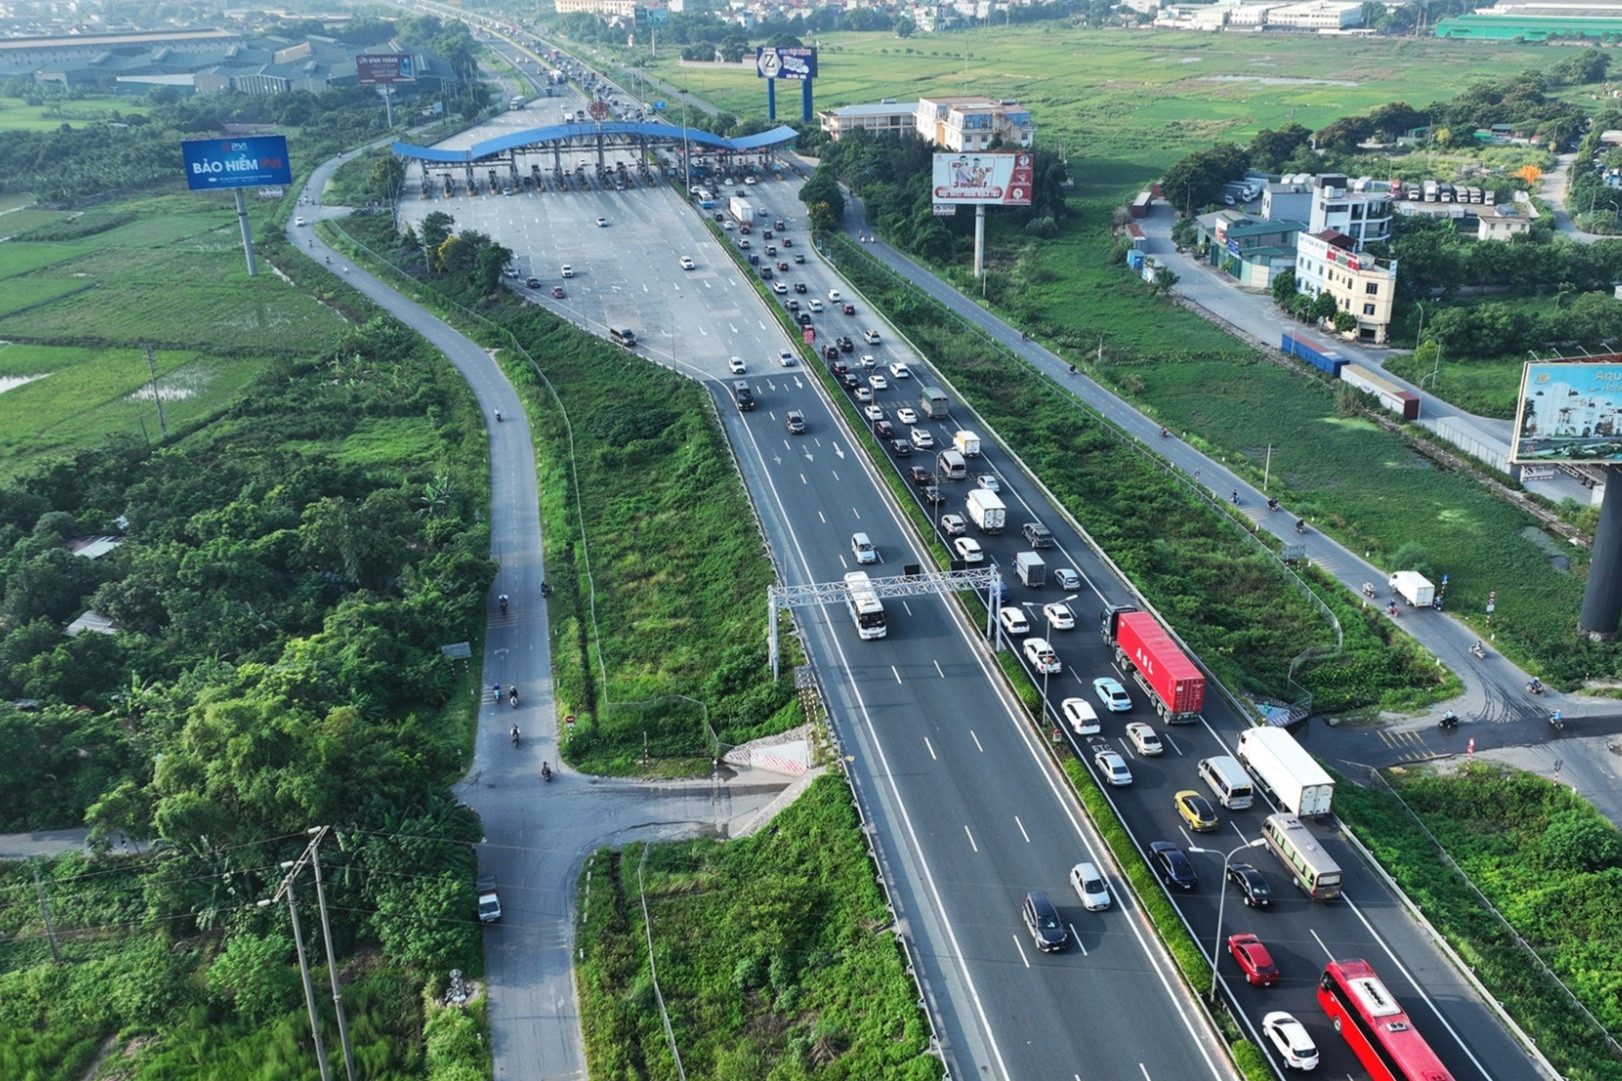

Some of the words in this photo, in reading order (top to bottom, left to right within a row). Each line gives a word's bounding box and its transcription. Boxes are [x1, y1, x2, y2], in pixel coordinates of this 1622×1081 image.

[764, 54, 775, 68] Z
[231, 142, 248, 150] PVI
[193, 158, 223, 174] BẢO
[225, 154, 259, 172] HIỂM
[260, 158, 283, 171] PVI
[1091, 744, 1112, 752] ETC
